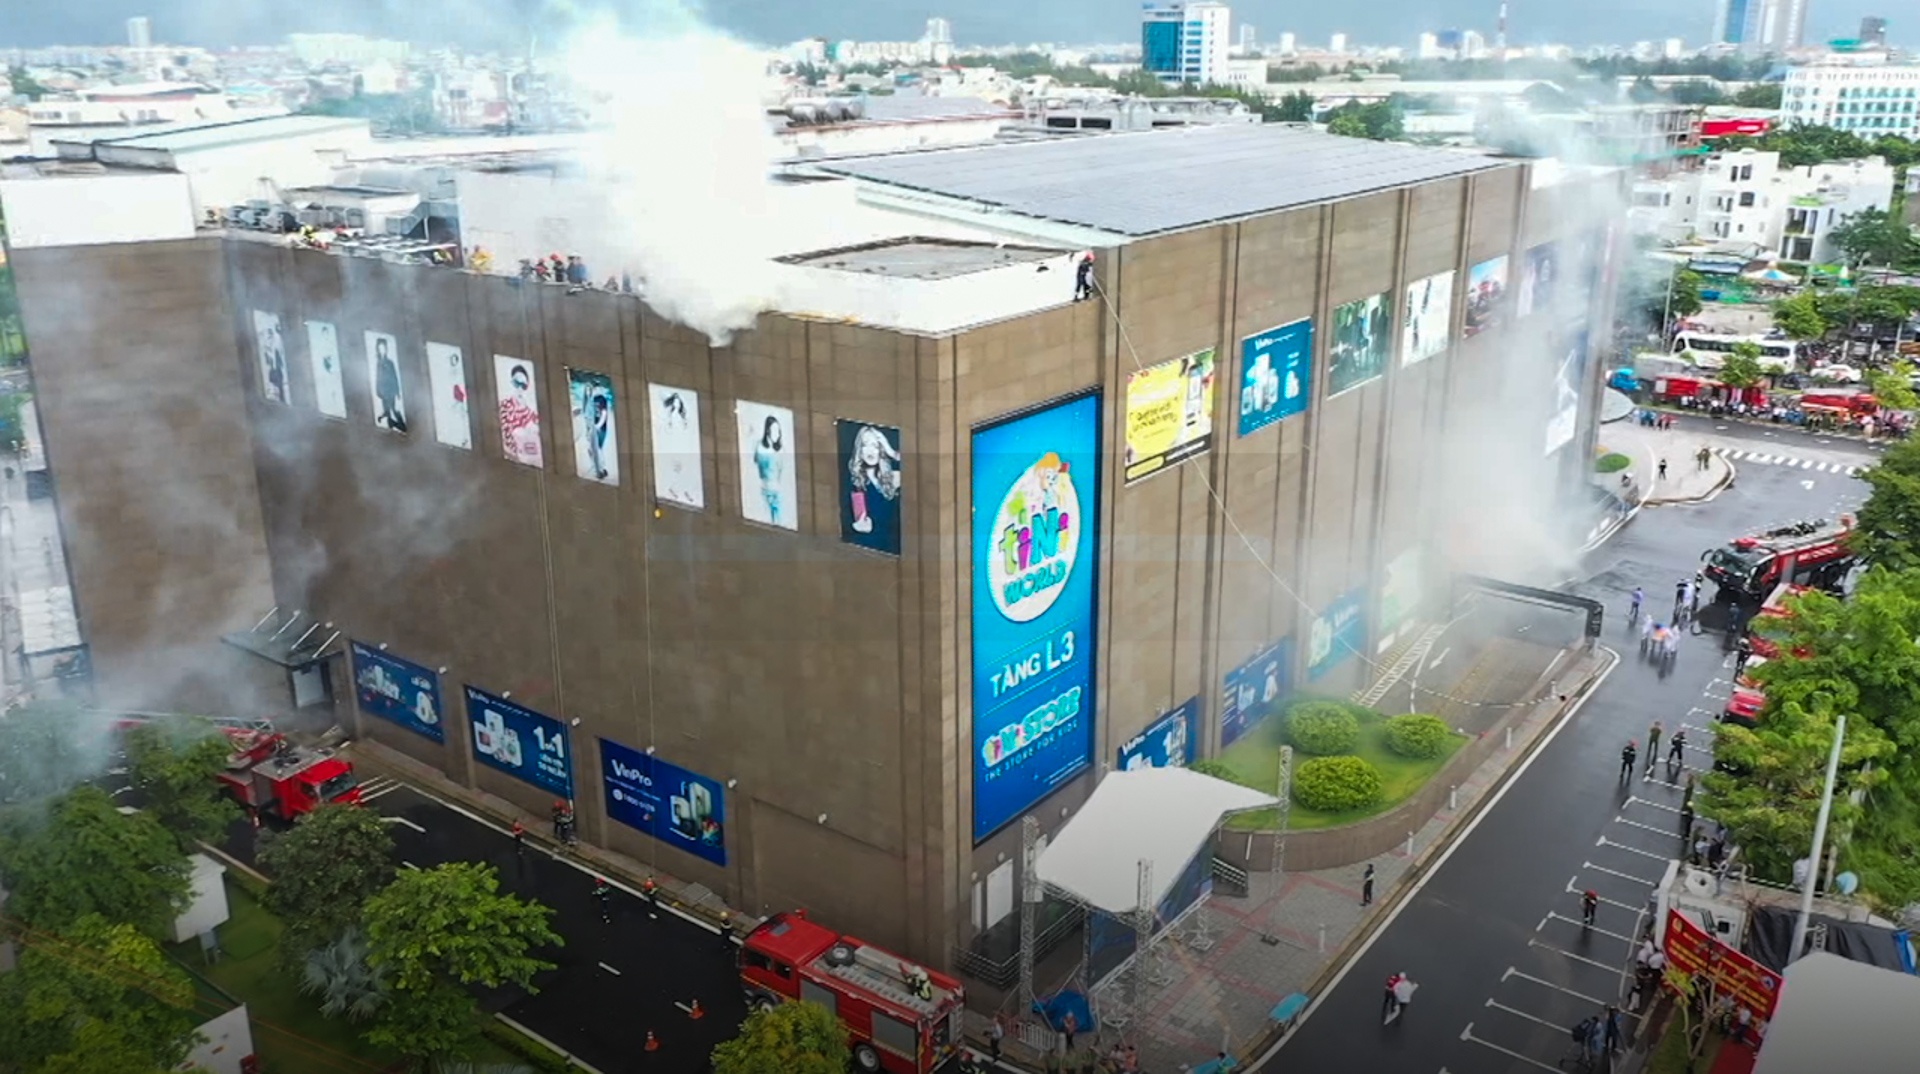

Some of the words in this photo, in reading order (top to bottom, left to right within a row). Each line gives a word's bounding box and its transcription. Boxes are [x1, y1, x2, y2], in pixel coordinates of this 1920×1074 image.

[999, 506, 1070, 575] tiNi
[1004, 559, 1066, 607] WORLD
[1046, 630, 1075, 672] L3
[611, 758, 653, 787] VinPro
[985, 767, 1001, 782] THE
[1005, 747, 1033, 771] STORE
[1037, 733, 1055, 750] FOR
